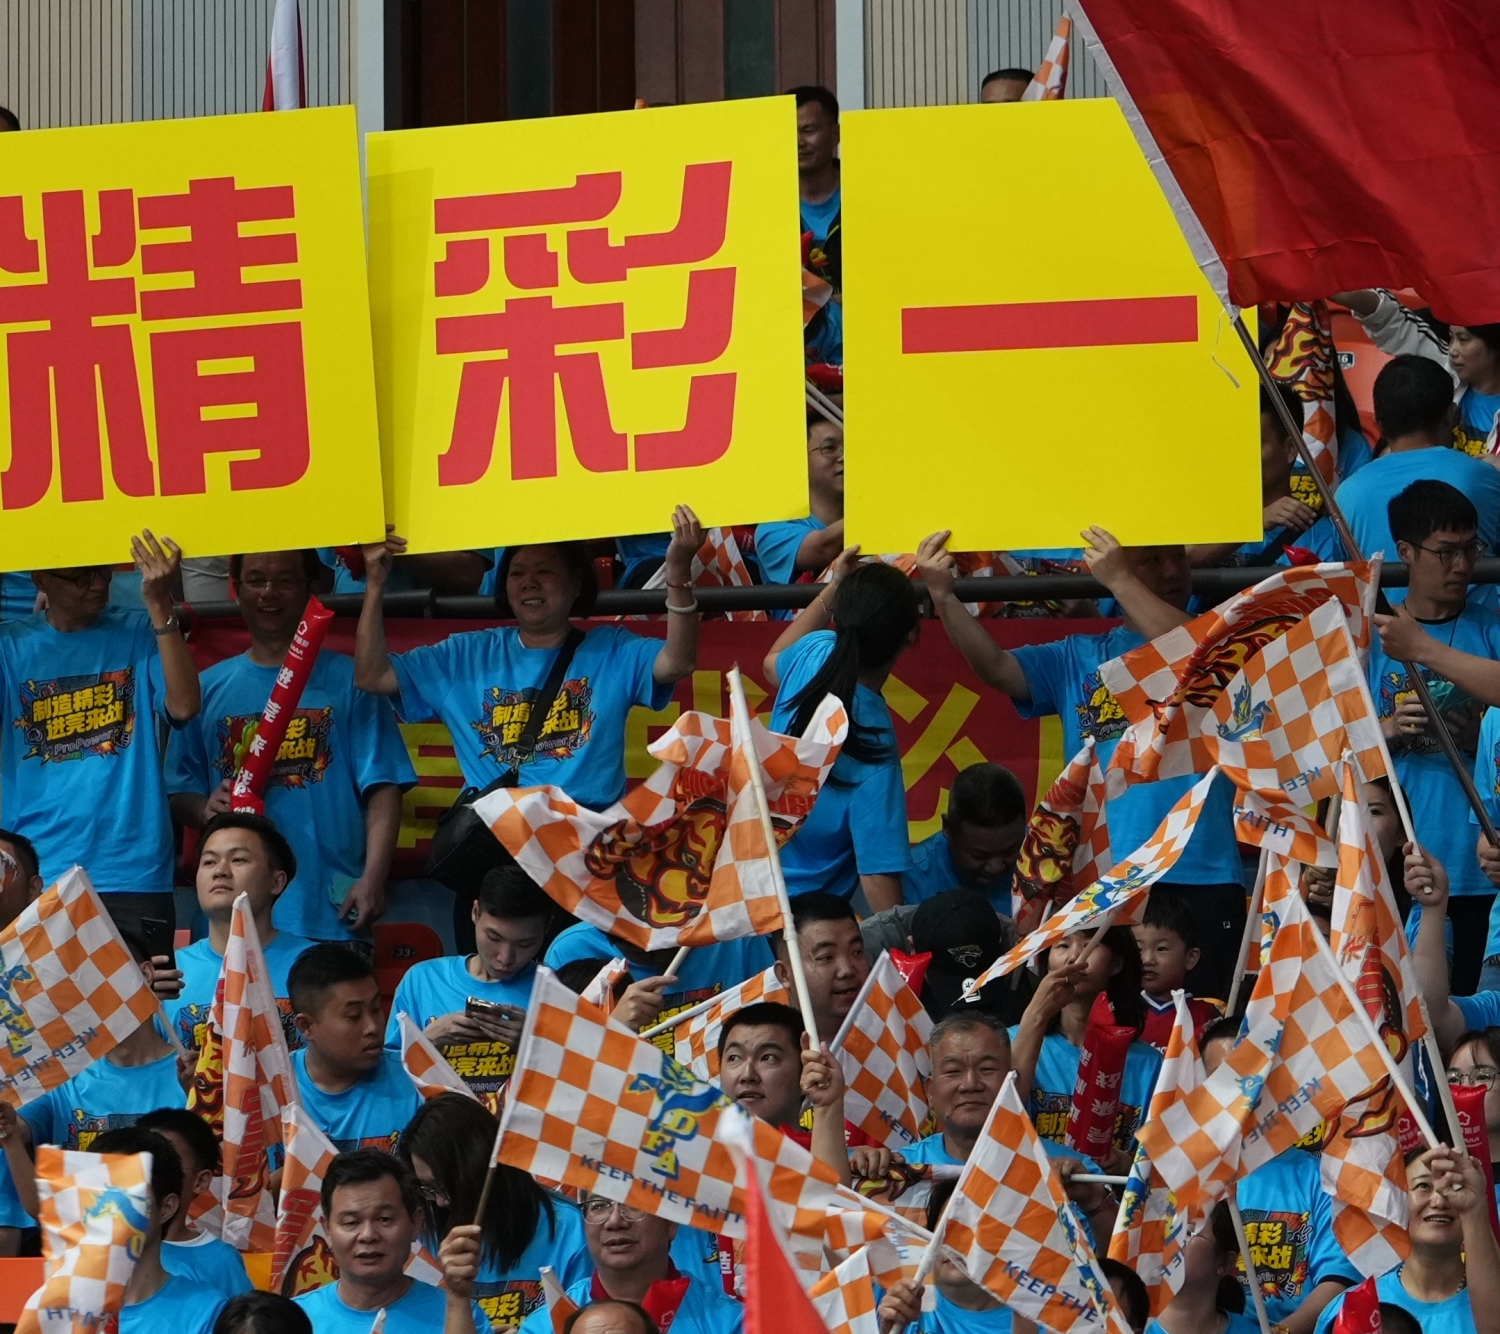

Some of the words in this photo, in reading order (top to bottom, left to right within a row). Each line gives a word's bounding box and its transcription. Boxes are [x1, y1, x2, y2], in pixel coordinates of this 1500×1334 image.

[32, 682, 115, 723] 制造精彩
[46, 701, 124, 741] 进莞来战
[580, 1154, 636, 1185] KEEP
[638, 1179, 681, 1207] THE
[1002, 1260, 1056, 1299] KEEP
